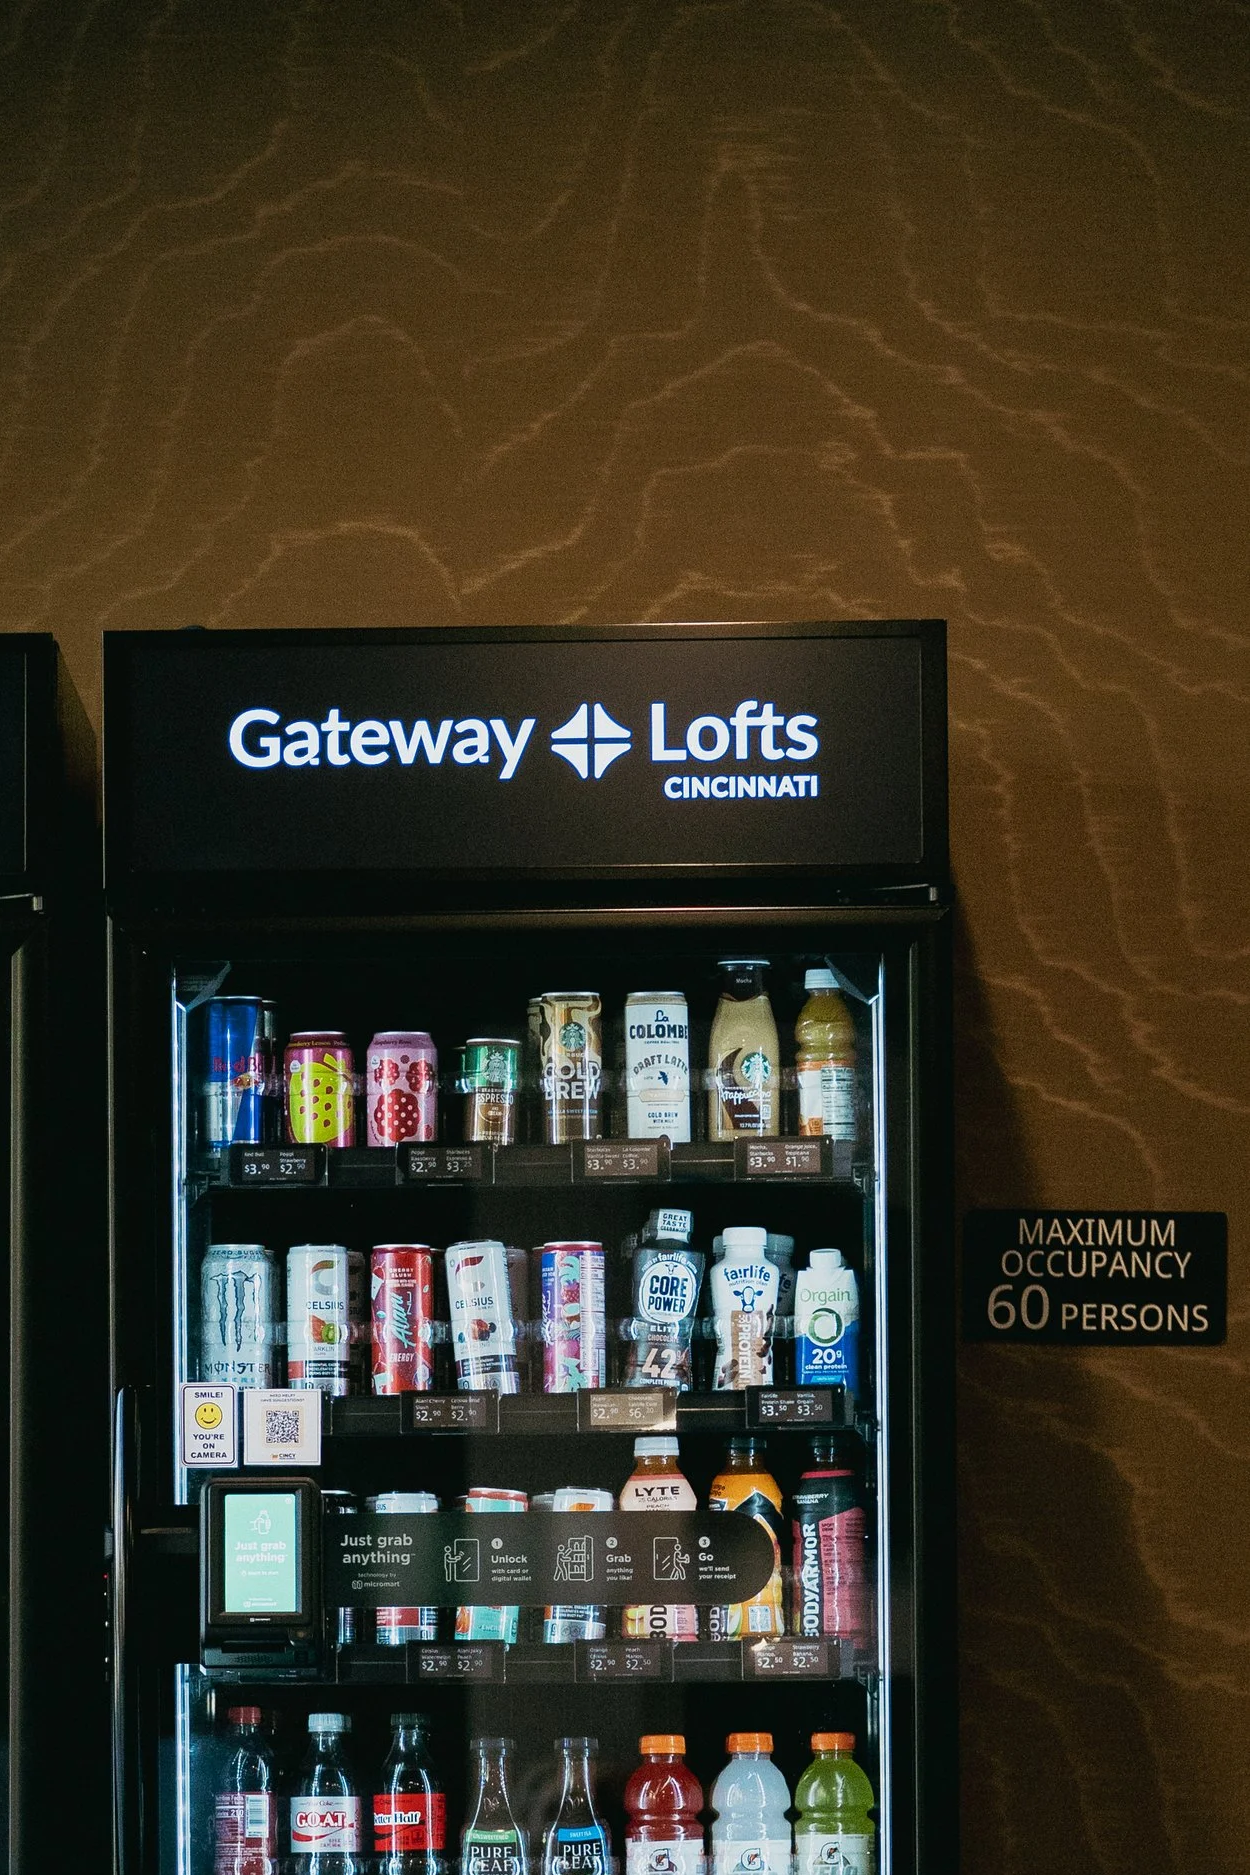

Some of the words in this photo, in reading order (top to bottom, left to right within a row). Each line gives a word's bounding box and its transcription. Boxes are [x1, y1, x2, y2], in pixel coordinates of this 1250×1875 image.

[228, 708, 536, 780] Gateway
[651, 700, 818, 762] Lofts
[663, 774, 818, 799] CINCINNATI
[544, 1062, 601, 1080] COLD
[633, 1056, 662, 1075] DRAFT
[544, 1082, 601, 1100] BREW
[662, 1213, 688, 1222] GREAT
[662, 1219, 688, 1228] TASTE
[1018, 1217, 1176, 1247] MAXIMUM
[1001, 1250, 1192, 1279] OCCUPANCY
[649, 1275, 689, 1296] CORE
[800, 1288, 851, 1303] Orgain
[305, 1301, 345, 1310] CELSIUS
[455, 1296, 494, 1310] CELSIUS
[649, 1296, 686, 1314] POWER
[987, 1283, 1050, 1330] 60
[1061, 1303, 1210, 1333] PERSONS
[738, 1323, 750, 1378] PROTEIN
[204, 1360, 271, 1376] MONSTER
[194, 1391, 224, 1399] SMILE!
[193, 1433, 225, 1441] YOU'RE
[202, 1442, 216, 1450] ON
[190, 1451, 228, 1460] CAMERA
[634, 1485, 680, 1497] LYTE
[340, 1534, 372, 1547] Just
[377, 1533, 413, 1549] grab
[701, 1538, 707, 1546] 3
[342, 1551, 411, 1566] anything
[491, 1554, 528, 1564] Unlock
[606, 1553, 632, 1564] Grab
[698, 1552, 714, 1562] Go
[606, 1567, 634, 1575] anything
[713, 1573, 737, 1581] receipt
[364, 1580, 400, 1588] micromart
[471, 1846, 513, 1859] PURE
[563, 1842, 601, 1856] PURE
